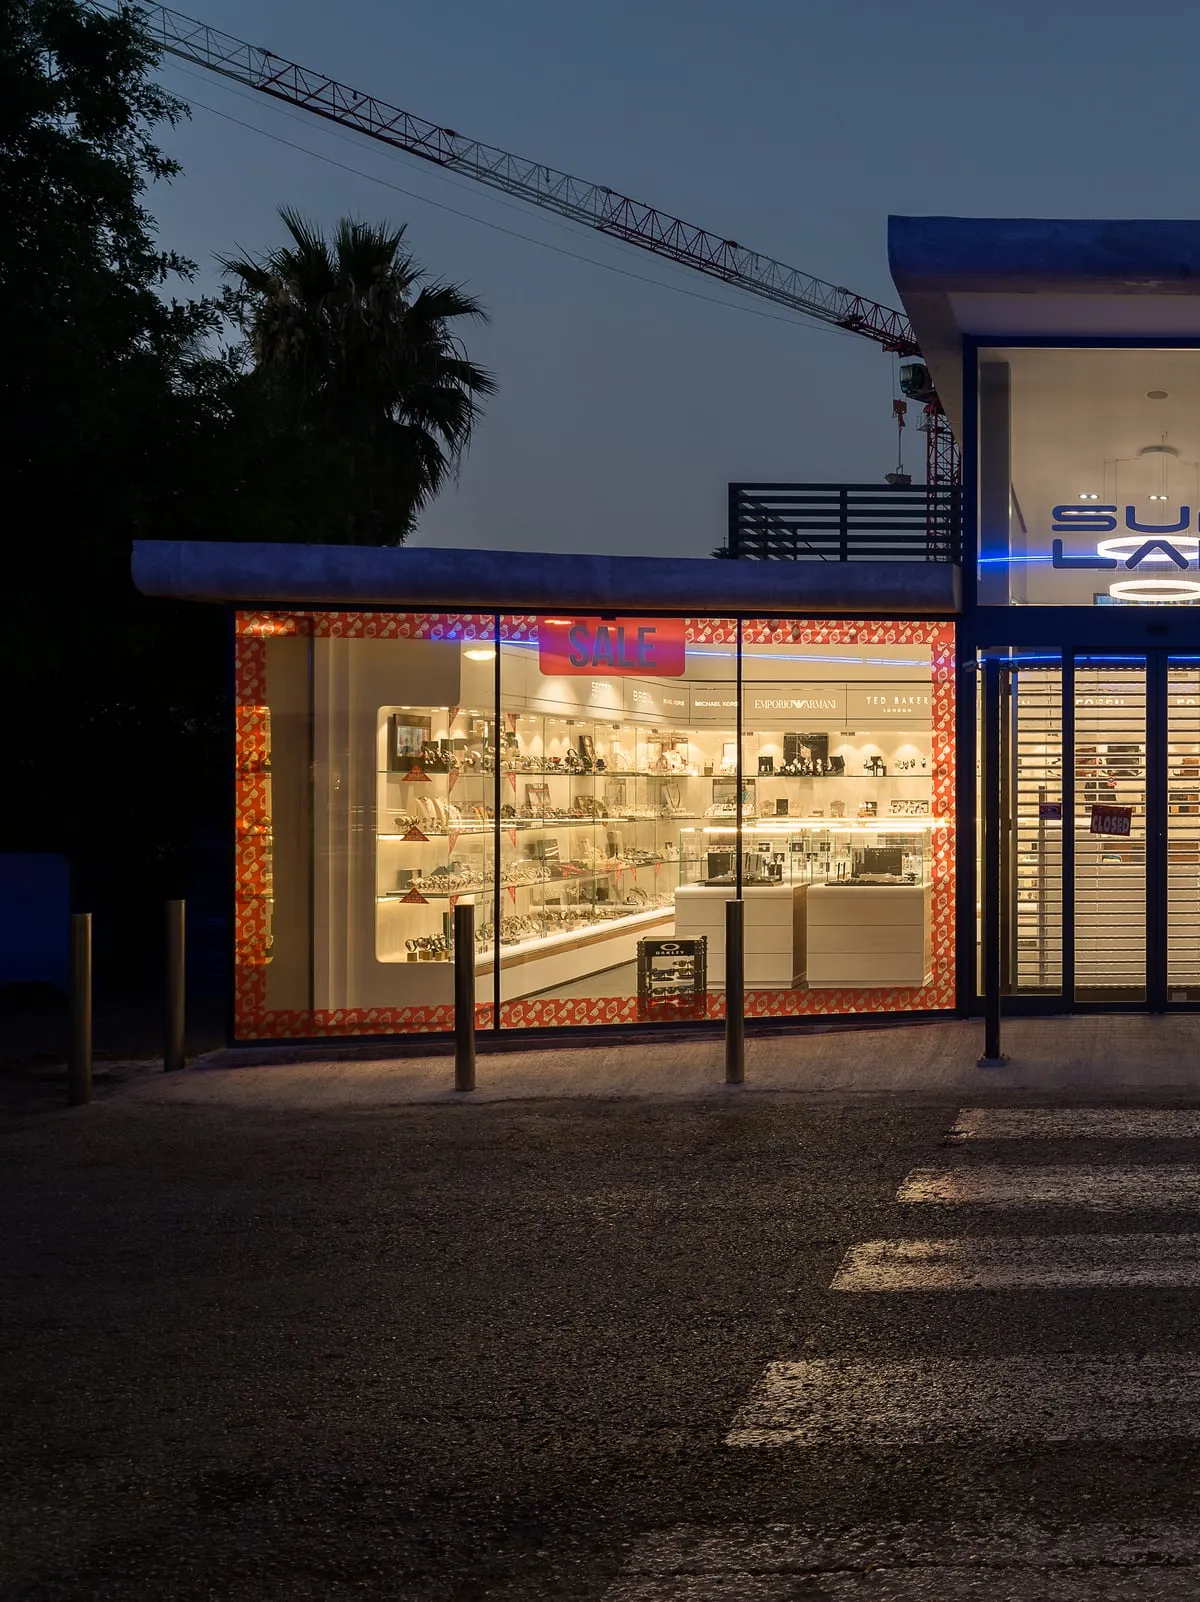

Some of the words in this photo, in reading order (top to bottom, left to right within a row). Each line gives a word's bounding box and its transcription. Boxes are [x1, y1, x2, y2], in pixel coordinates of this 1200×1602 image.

[568, 624, 657, 667] SALE
[722, 700, 738, 708] KORS
[754, 699, 793, 709] EMPORIO
[803, 699, 836, 709] ARMANI
[866, 696, 887, 705] TED
[894, 696, 929, 705] BAKER
[1091, 815, 1130, 834] CLOSED
